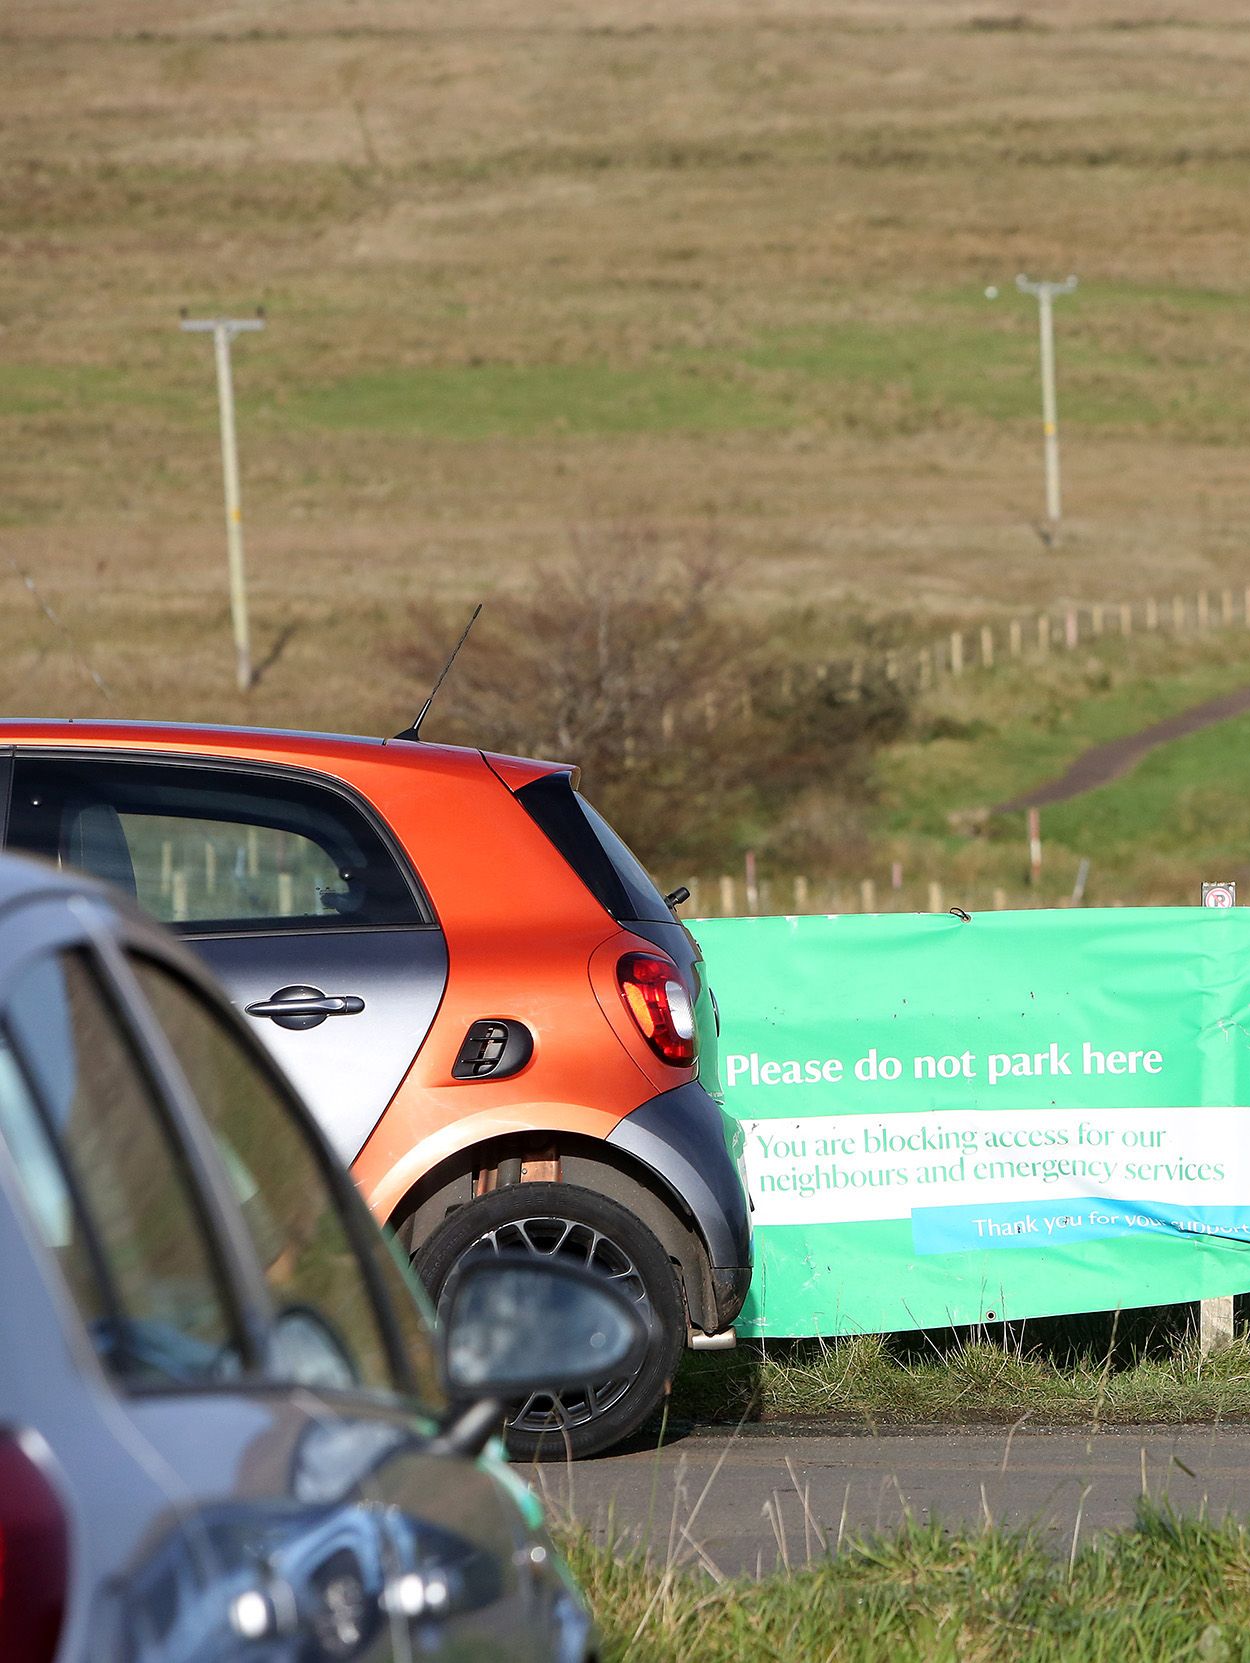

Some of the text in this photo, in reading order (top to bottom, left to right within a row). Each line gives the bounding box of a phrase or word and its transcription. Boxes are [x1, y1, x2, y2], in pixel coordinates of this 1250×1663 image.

[726, 1042, 1163, 1087] Please do not park here
[756, 1121, 1167, 1159] You are blocking access for our
[760, 1156, 1226, 1199] neighbours and emergency services
[971, 1214, 1040, 1238] Thank
[1043, 1215, 1082, 1235] you
[1088, 1210, 1121, 1226] for
